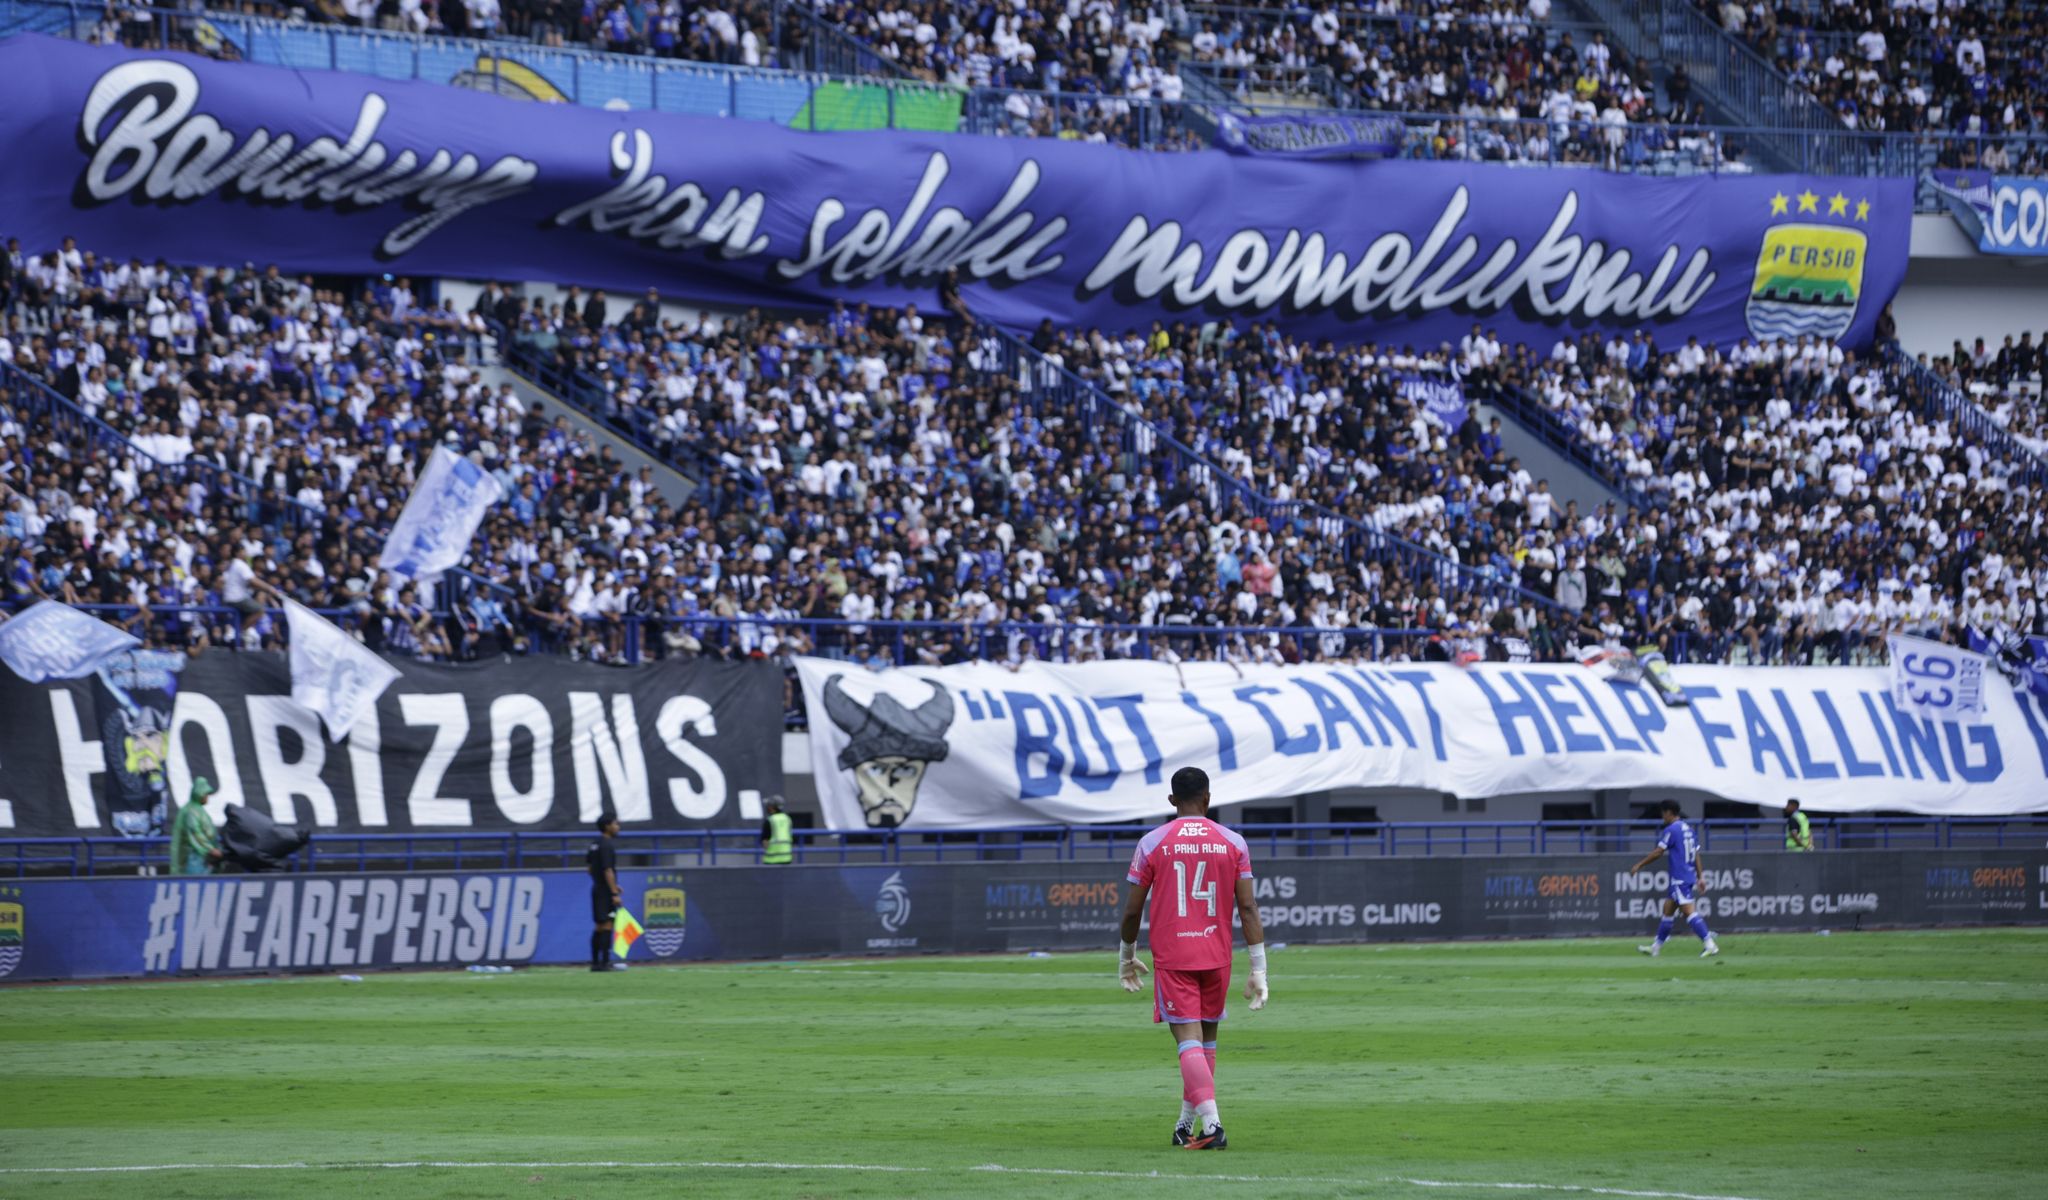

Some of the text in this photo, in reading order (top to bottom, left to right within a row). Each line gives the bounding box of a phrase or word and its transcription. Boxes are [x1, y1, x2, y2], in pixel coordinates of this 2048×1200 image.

[82, 60, 538, 255] Bandung
[778, 151, 1068, 282] selalu
[1085, 185, 1716, 319] memelukmu
[1773, 245, 1856, 270] PERSIB
[1903, 653, 1956, 708] 93
[1182, 692, 1238, 771] I
[1233, 669, 1448, 762] CAN'T
[1467, 671, 1668, 756] HELP
[1683, 686, 2004, 783] FALLING
[1177, 827, 1209, 837] ABC
[1162, 843, 1227, 856] T. PAKU ALAM
[1173, 861, 1217, 917] 14
[1485, 875, 1536, 897] MITRA
[1615, 868, 1754, 892] INDOSIA'S
[1926, 867, 1970, 888] MITRA
[985, 883, 1045, 906] MITRA
[1615, 896, 1711, 919] LEAG
[1717, 894, 1805, 917] SPORTS
[143, 875, 543, 972] #WEAREPERSIB
[1257, 903, 1356, 928] SPORTS
[1362, 902, 1442, 925] CLINIC
